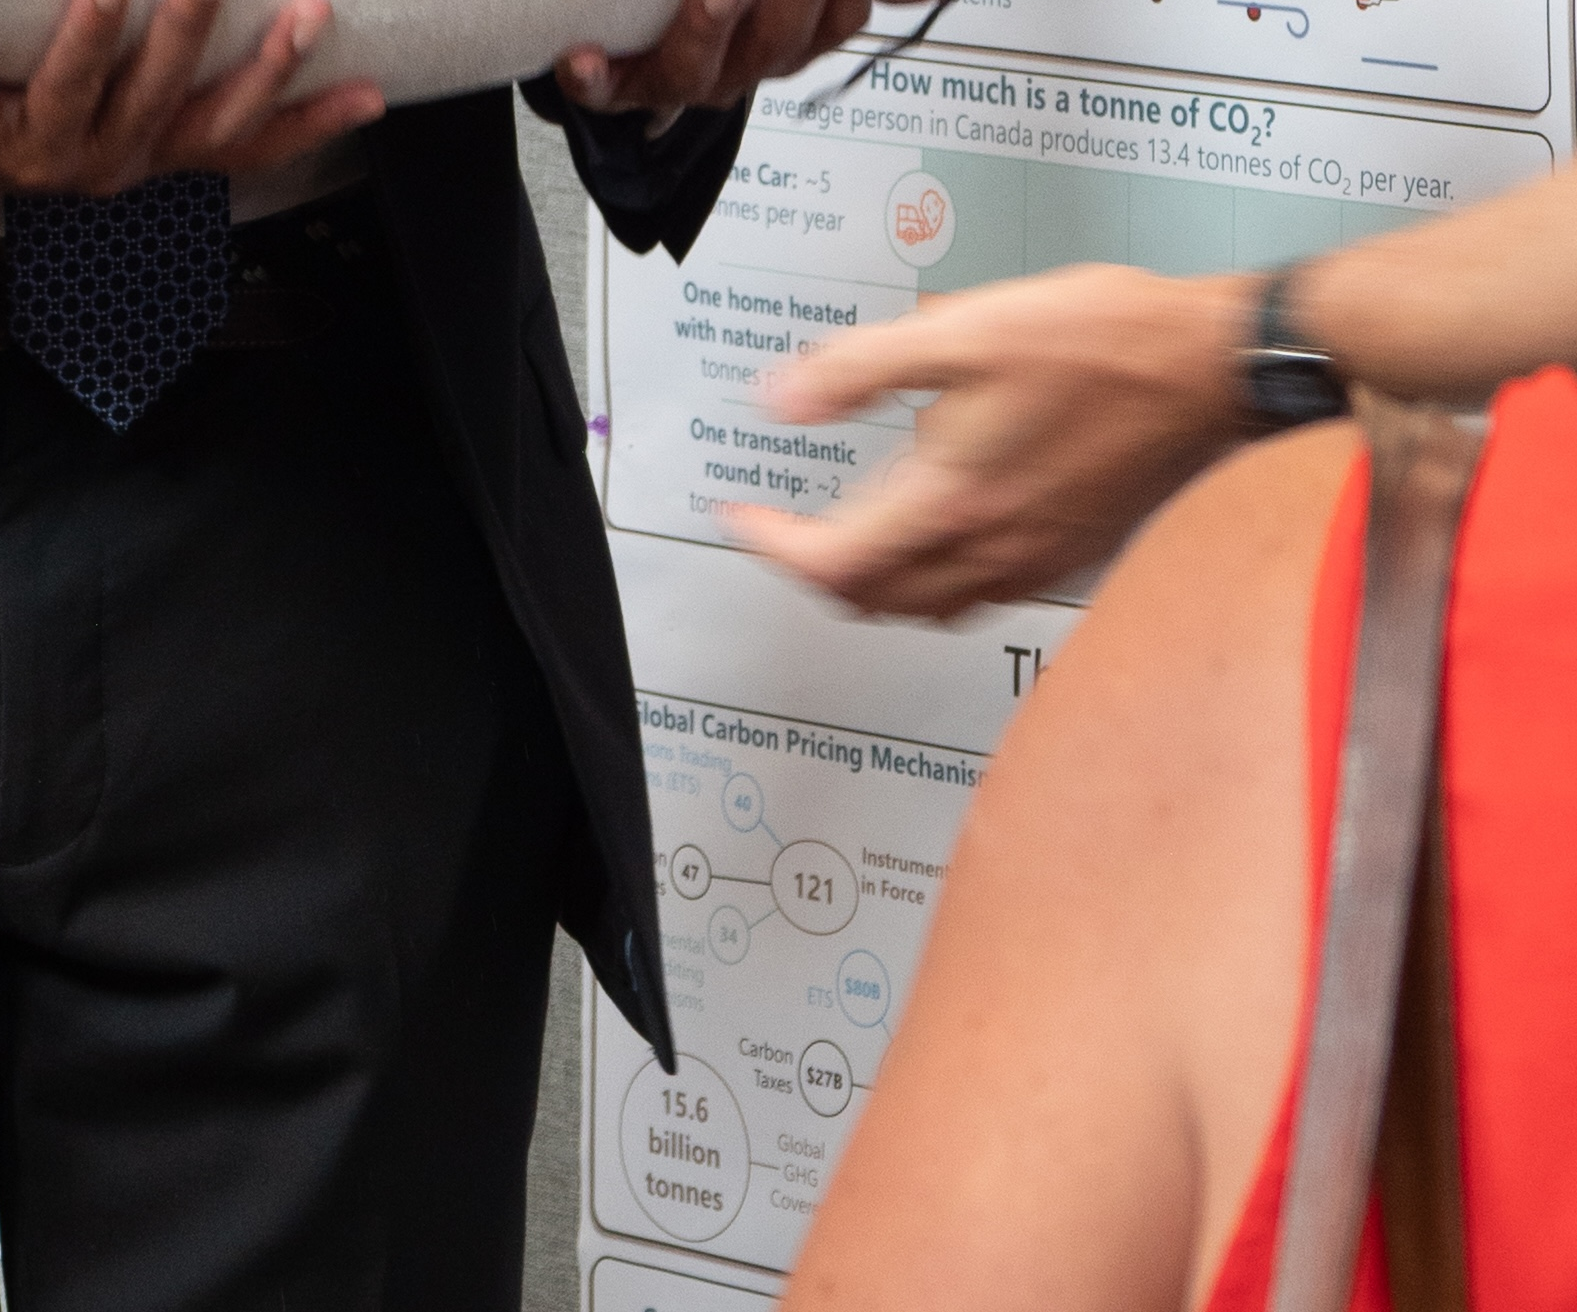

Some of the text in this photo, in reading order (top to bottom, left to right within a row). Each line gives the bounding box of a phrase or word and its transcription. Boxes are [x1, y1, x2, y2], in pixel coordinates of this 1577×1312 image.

[870, 61, 931, 97] How
[942, 73, 1016, 108] much
[1026, 78, 1046, 110] is
[1055, 91, 1070, 114] a
[1079, 88, 1162, 124] tonne
[1171, 96, 1200, 129] of
[851, 107, 923, 135] person
[929, 110, 949, 137] in
[955, 114, 1034, 148] Canada
[1040, 124, 1139, 162] produces
[1147, 138, 1190, 167] 13.4
[1197, 144, 1272, 177] tonnes
[1279, 155, 1301, 180] of
[1360, 171, 1397, 196] per
[1404, 176, 1455, 203] year.
[757, 163, 798, 188] Car:
[766, 201, 846, 236] per year
[683, 281, 858, 326] One home heated
[673, 318, 716, 344] with
[721, 325, 792, 355] natural
[690, 417, 858, 467] One transatlantic
[705, 459, 810, 500] round trip:
[701, 713, 864, 773] Carbon Pricing
[682, 864, 700, 882] 47
[794, 872, 834, 906] 121
[861, 875, 926, 906] in Force
[738, 1037, 794, 1067] Carbon
[753, 1068, 794, 1095] Taxes
[661, 1088, 710, 1124] 15.6
[648, 1126, 721, 1170] billion
[644, 1172, 724, 1213] tonnes
